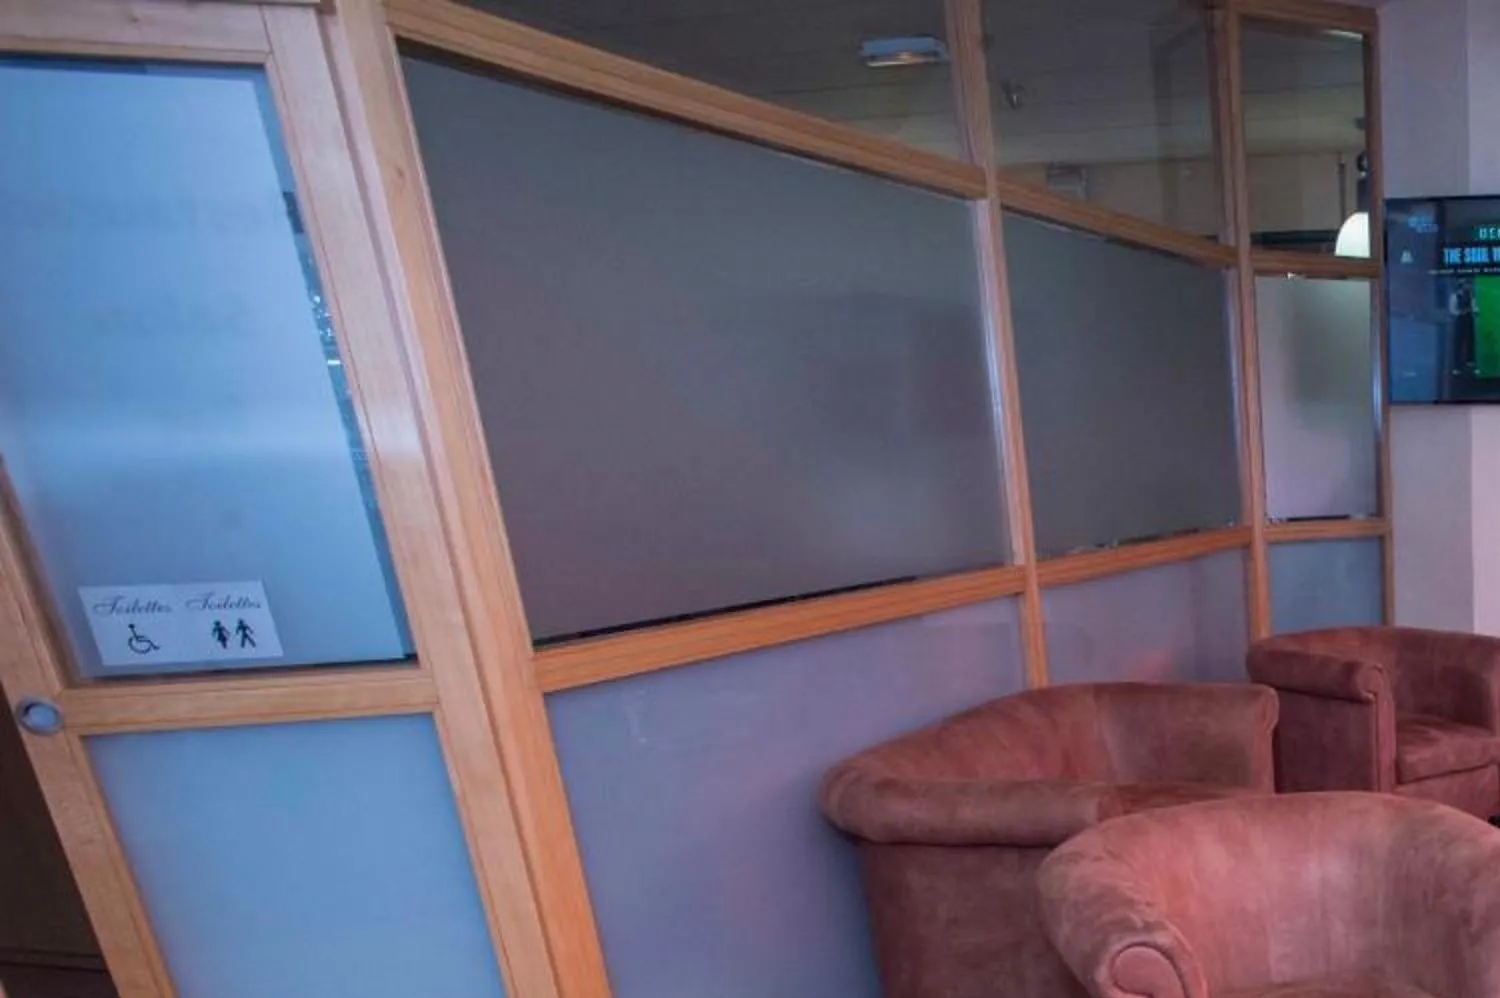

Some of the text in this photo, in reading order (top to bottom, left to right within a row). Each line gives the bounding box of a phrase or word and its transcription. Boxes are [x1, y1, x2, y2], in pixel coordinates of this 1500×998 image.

[1443, 247, 1462, 264] THE
[93, 590, 261, 616] Toilettes Toilettes
